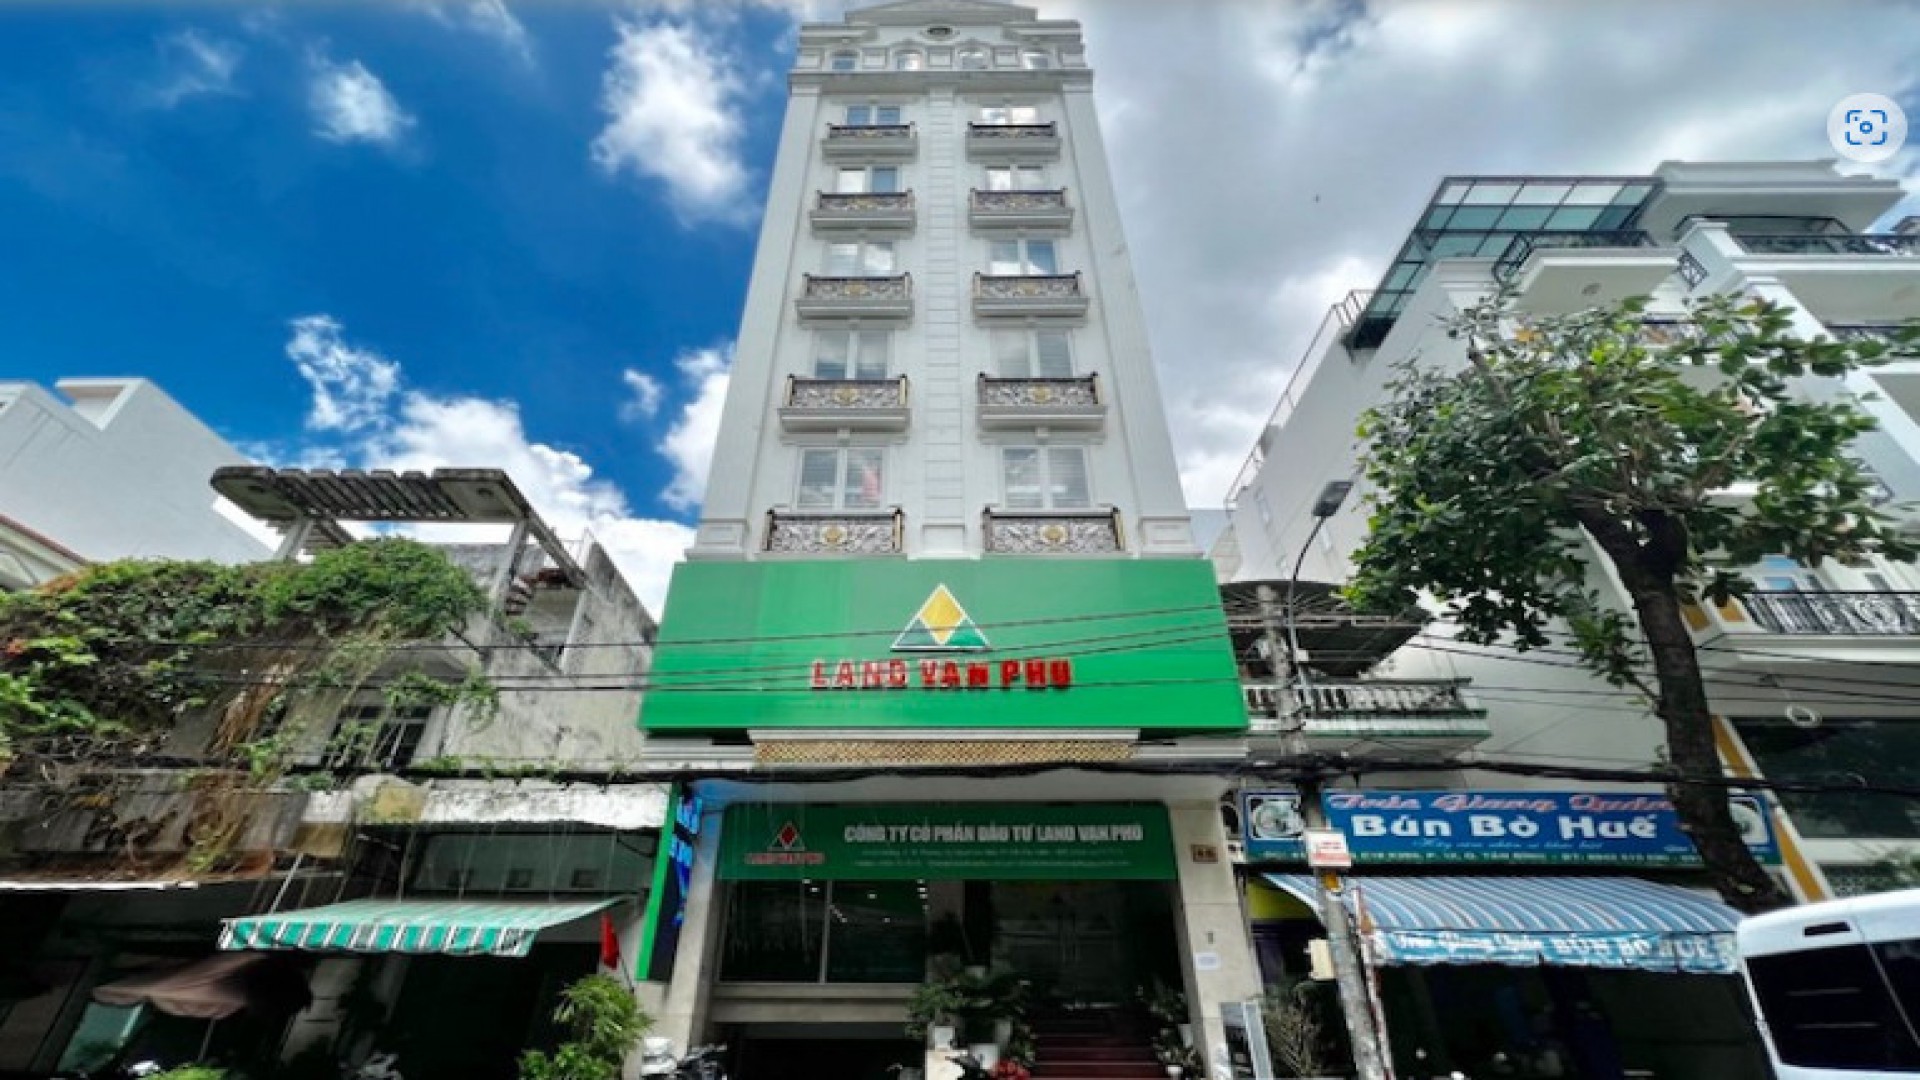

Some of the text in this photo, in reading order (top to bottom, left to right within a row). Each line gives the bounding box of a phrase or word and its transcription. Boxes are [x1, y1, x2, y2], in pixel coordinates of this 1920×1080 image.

[812, 658, 908, 690] LAND
[1350, 813, 1657, 839] Bún Bò Huế
